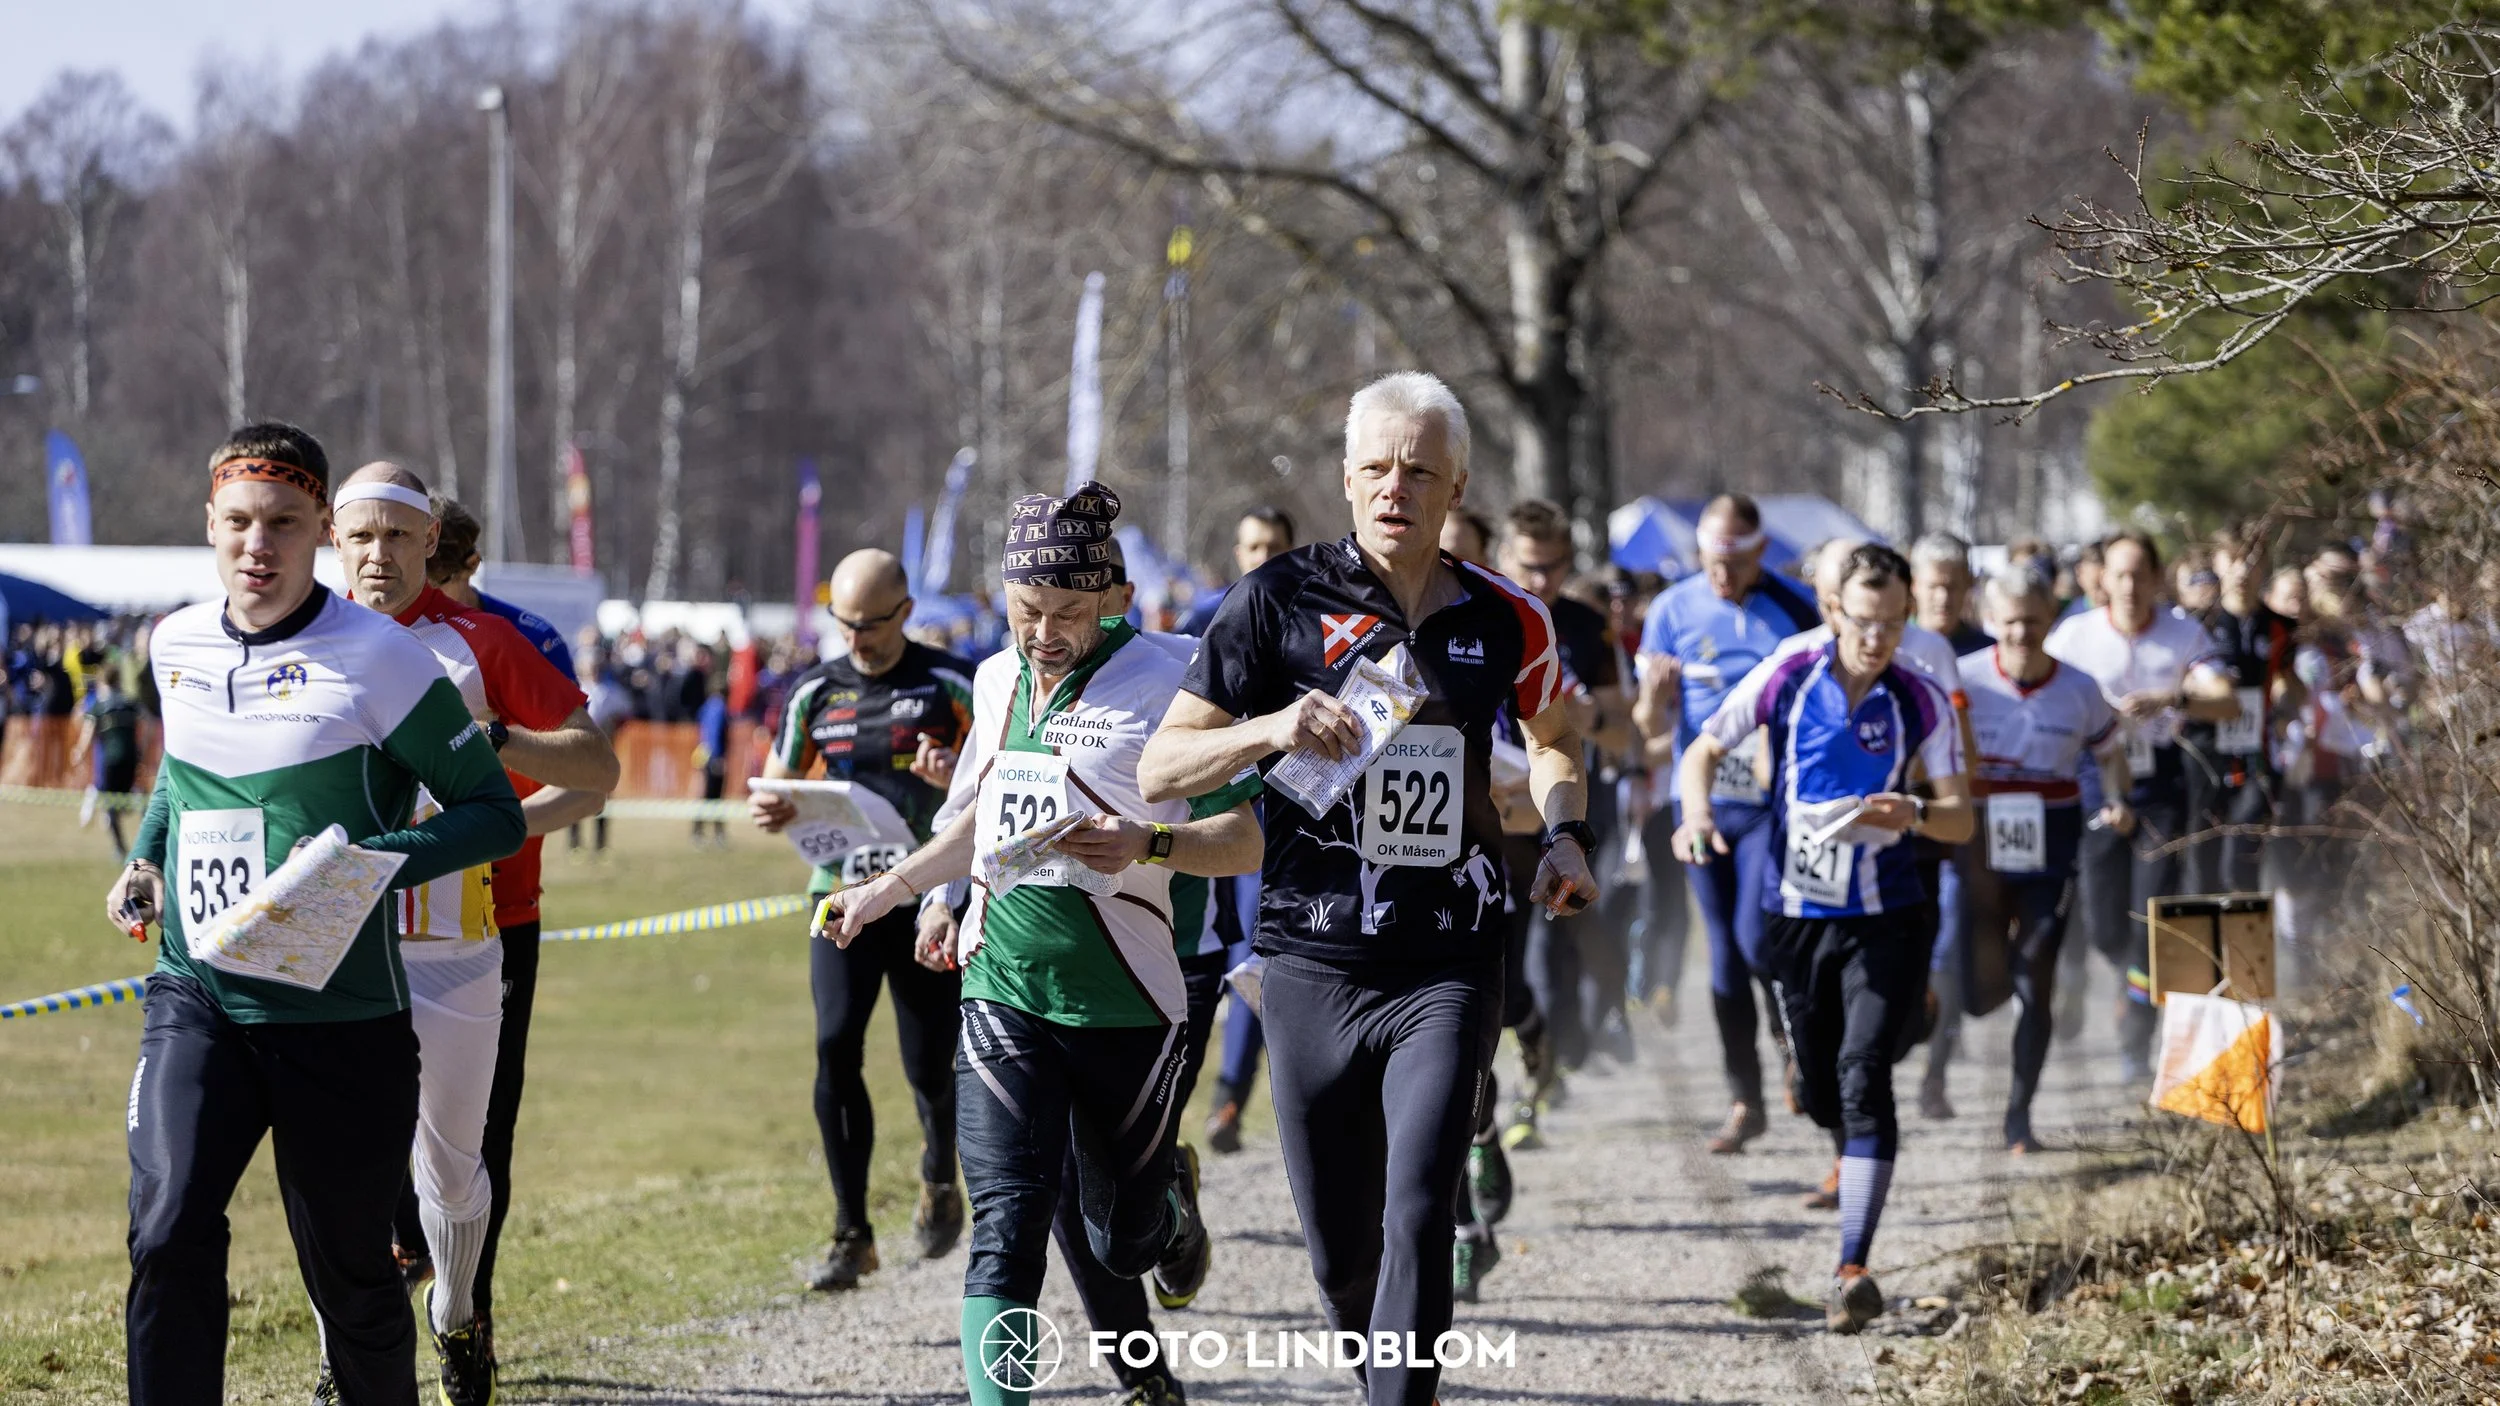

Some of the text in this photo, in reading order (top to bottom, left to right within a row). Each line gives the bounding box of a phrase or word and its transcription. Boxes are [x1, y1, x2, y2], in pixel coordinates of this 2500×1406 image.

[303, 714, 321, 724] OK
[1049, 713, 1113, 731] Gotlands
[1044, 731, 1108, 749] BRO OK
[1381, 743, 1430, 757] OREX
[998, 769, 1042, 783] NOREX
[1379, 769, 1451, 836] 522
[184, 830, 229, 845] NOREX
[1377, 844, 1446, 858] OK Måsen
[1031, 867, 1055, 877] sen
[189, 857, 250, 924] 533
